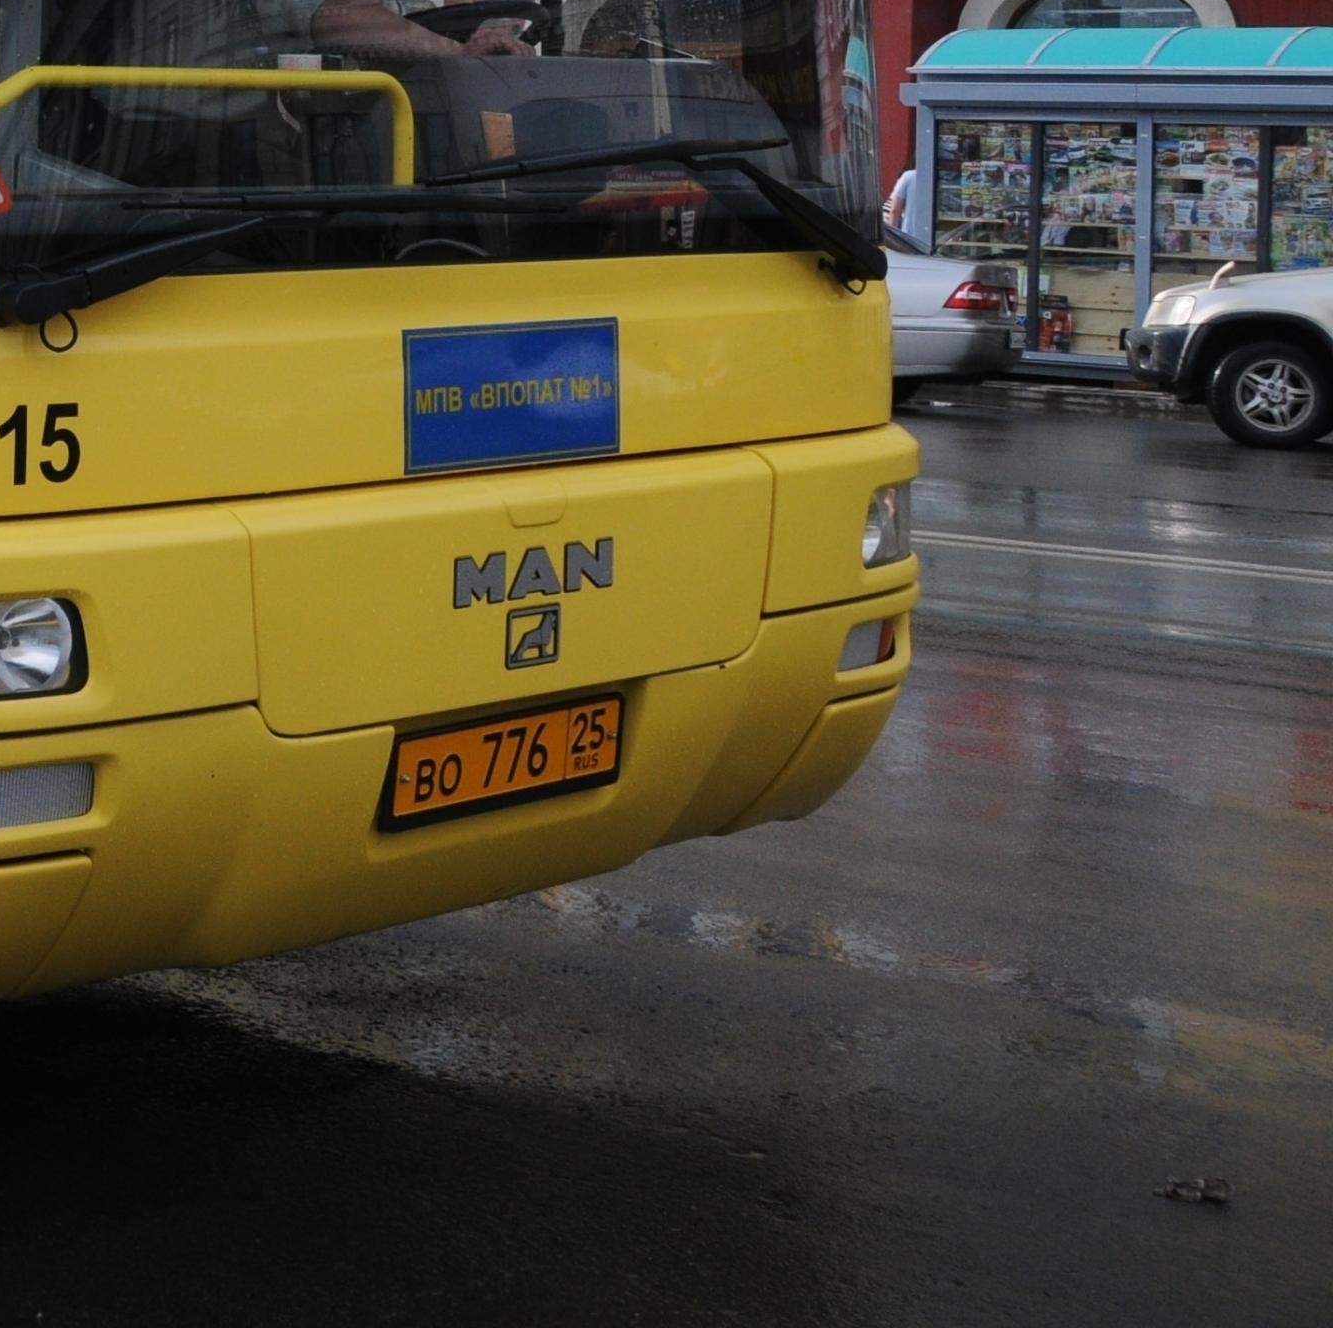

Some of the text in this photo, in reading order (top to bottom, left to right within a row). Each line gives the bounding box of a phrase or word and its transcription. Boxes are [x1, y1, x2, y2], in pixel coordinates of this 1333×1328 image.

[415, 373, 613, 415] МПВ «ВПОПАТ №1»
[452, 535, 615, 610] MAN
[414, 708, 606, 803] ВО 776 25
[573, 753, 599, 771] RUS
